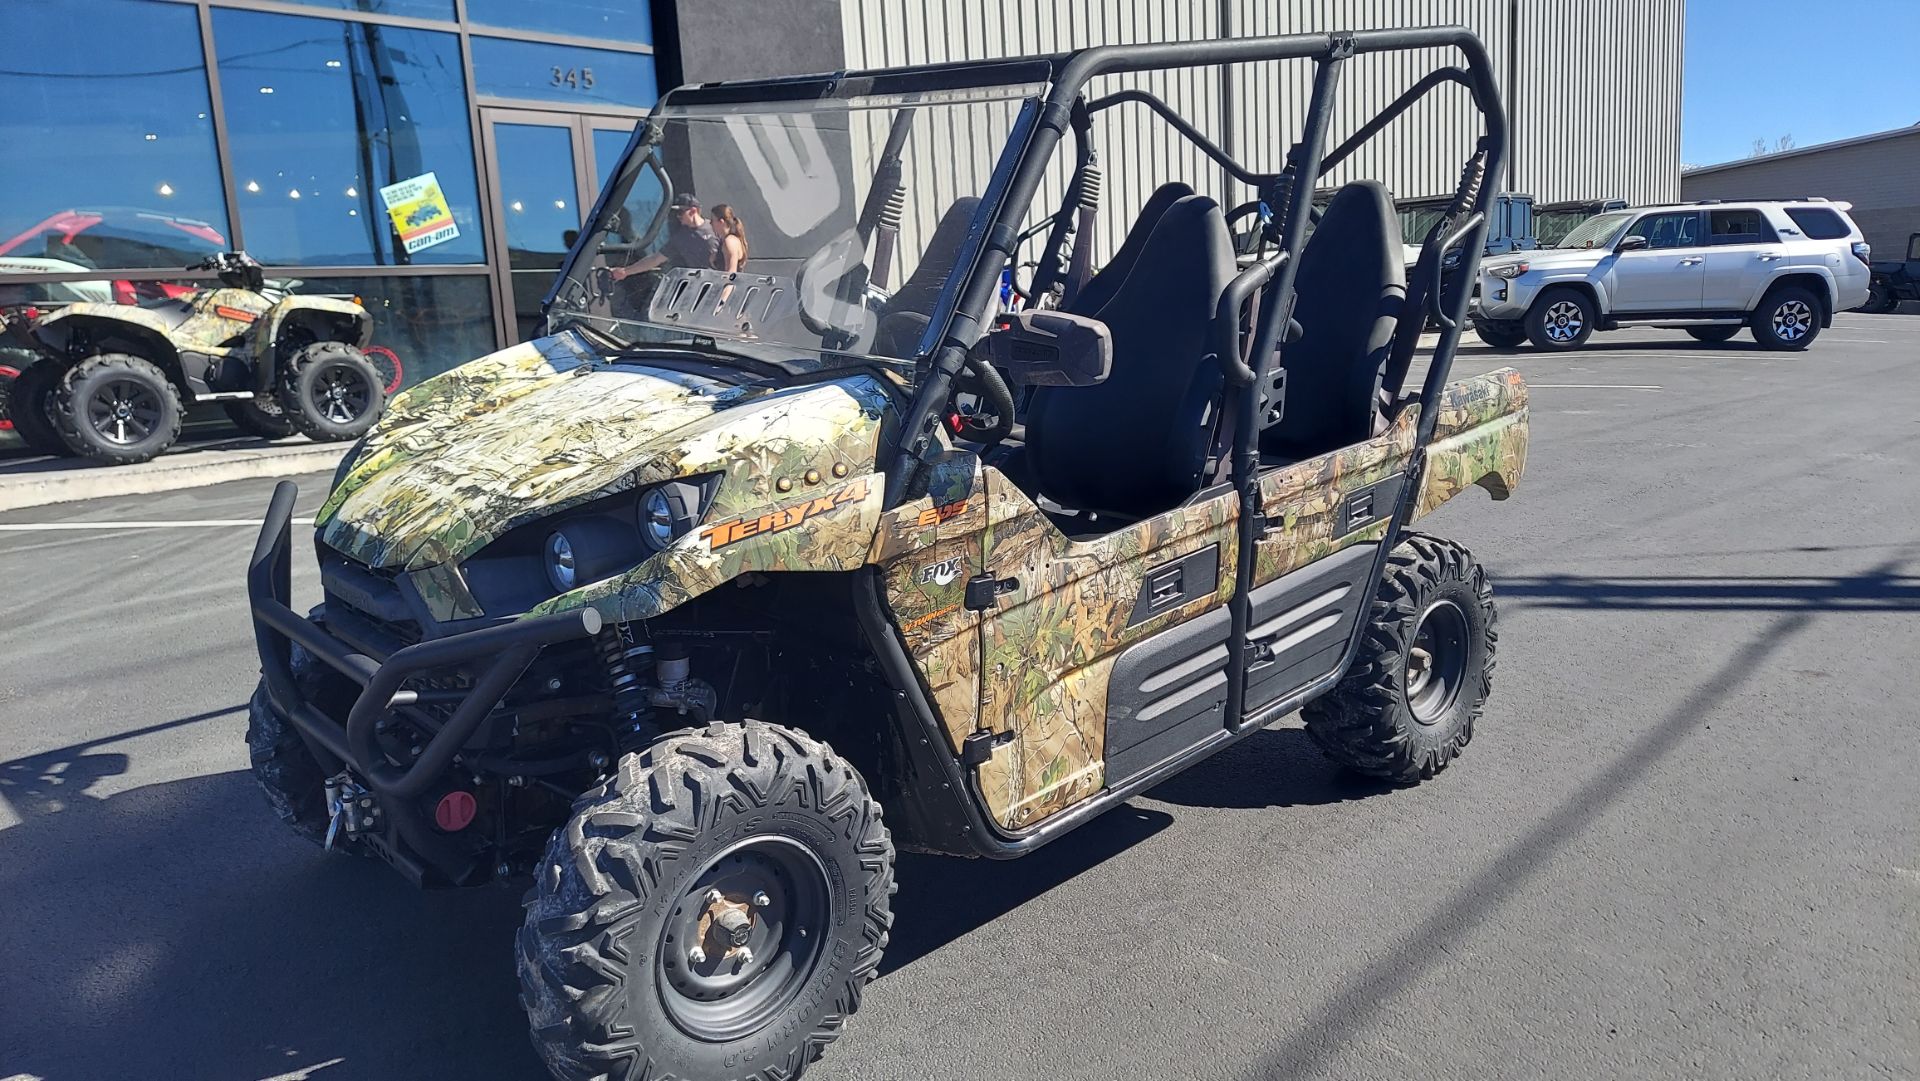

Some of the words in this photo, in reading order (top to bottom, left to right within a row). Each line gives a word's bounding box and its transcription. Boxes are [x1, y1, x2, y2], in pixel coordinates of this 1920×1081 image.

[549, 66, 593, 89] 345
[408, 227, 455, 250] can-am
[1451, 382, 1490, 408] Kawasaki
[921, 556, 963, 586] FOX
